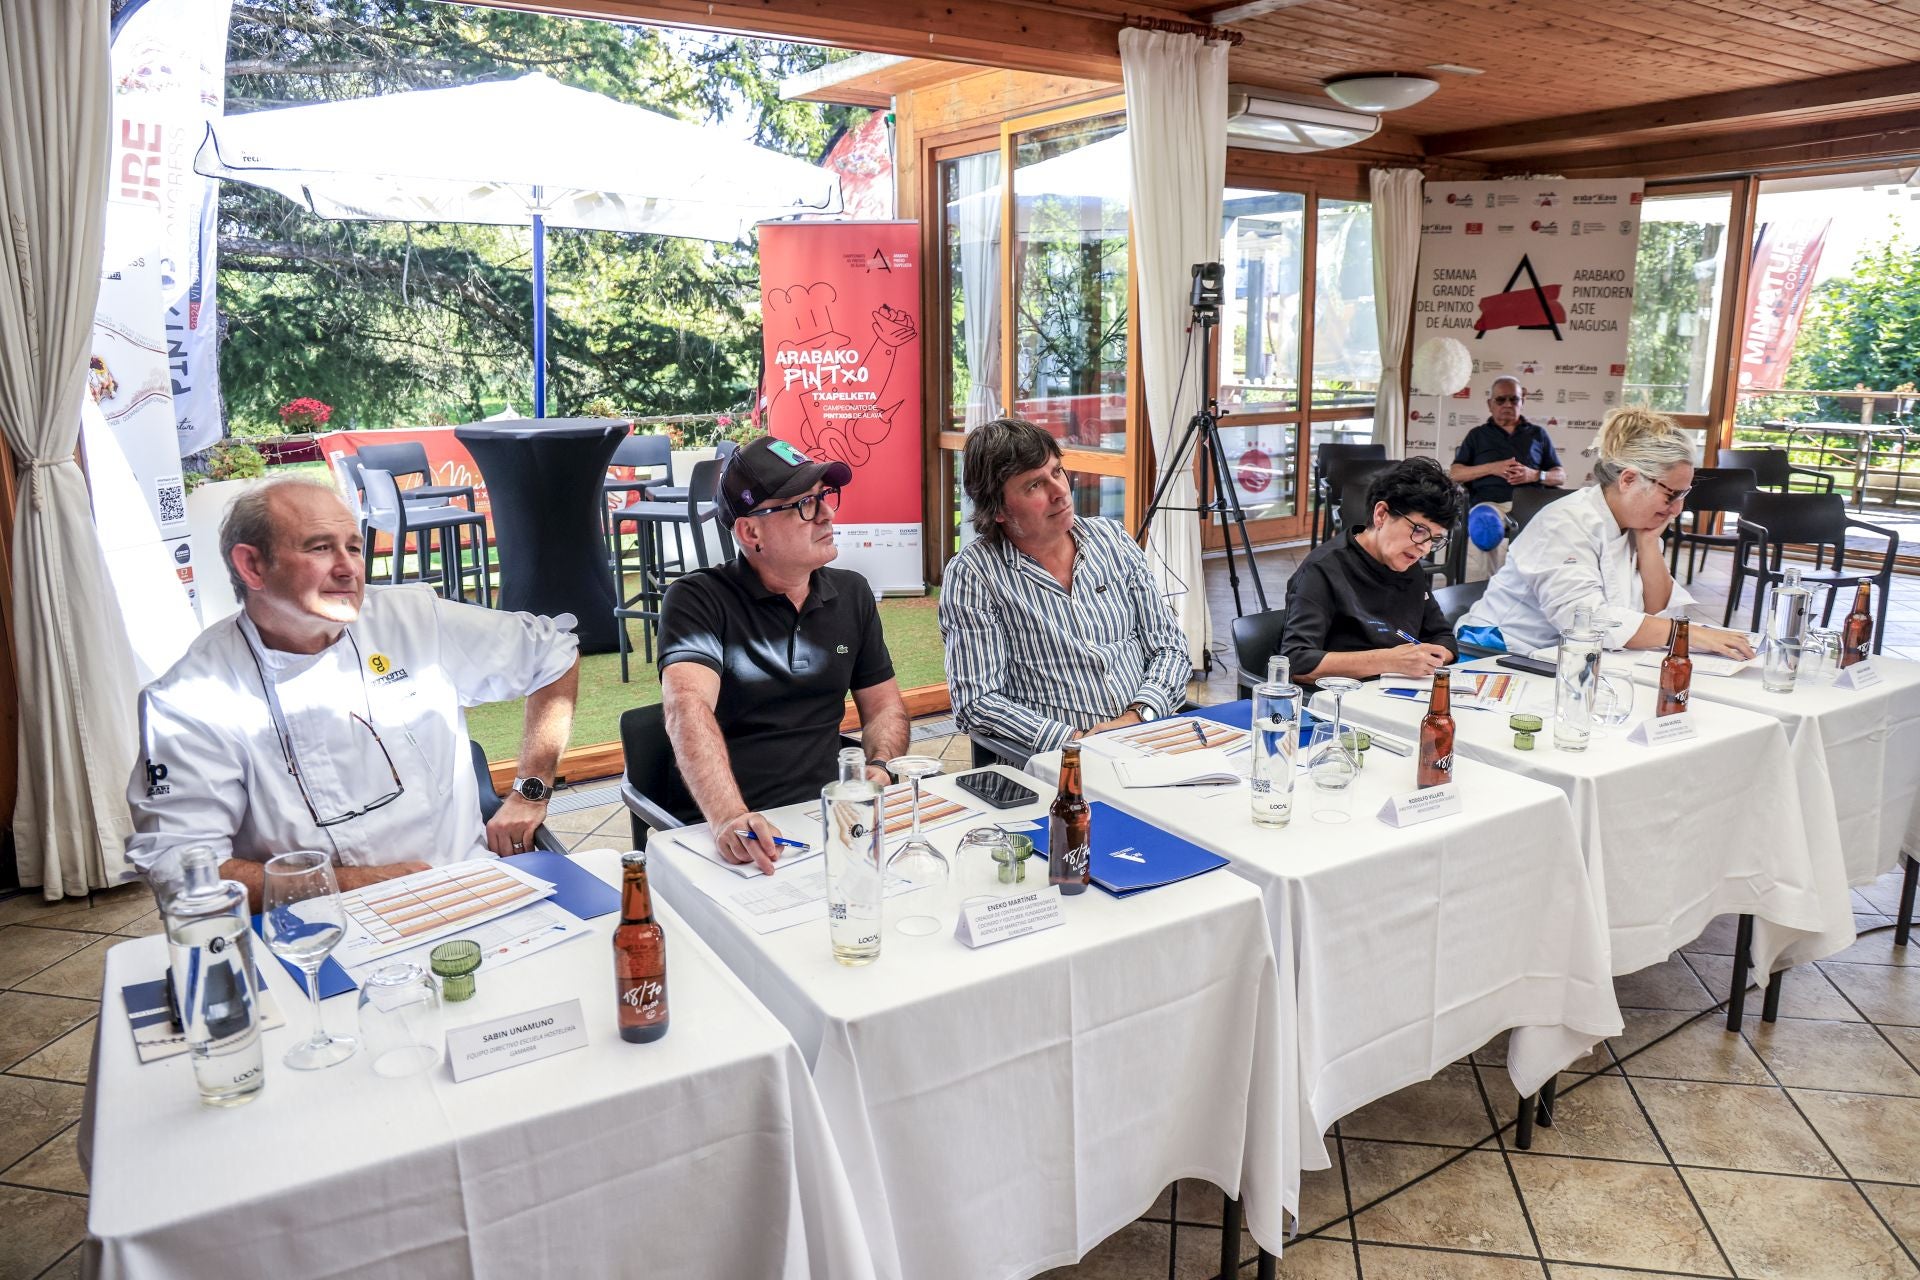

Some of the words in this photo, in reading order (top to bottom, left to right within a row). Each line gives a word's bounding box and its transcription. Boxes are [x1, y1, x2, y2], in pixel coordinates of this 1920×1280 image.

[1433, 269, 1477, 281] SEMANA
[1573, 270, 1625, 282] ARABAKO
[1433, 285, 1475, 297] GRANDE
[1572, 286, 1633, 299] PINTXOREN
[1417, 301, 1436, 312] DEL
[1437, 301, 1474, 313] PINTXO
[1570, 303, 1595, 315] ASTE
[1426, 317, 1440, 329] DE
[1441, 314, 1473, 329] ÁLAVA
[1569, 320, 1618, 332] NAGUSIA
[775, 349, 859, 365] ARABAKO
[784, 364, 869, 391] PINTXO
[812, 392, 877, 401] TXAPELKETA
[823, 404, 867, 412] CAMPEONATO
[987, 902, 1007, 912] ENEKO
[1008, 894, 1038, 907] MARTÍNEZ
[858, 934, 878, 944] LOCAL
[623, 980, 662, 1007] 18/70
[482, 1030, 508, 1043] SABIN
[510, 1017, 554, 1036] UNAMUNO
[466, 1049, 489, 1061] EQUIPO
[489, 1040, 519, 1054] DIRECTIVO
[520, 1034, 543, 1046] ESCUELA
[509, 1045, 537, 1057] GAMARRA
[233, 1066, 262, 1084] LOCAL
